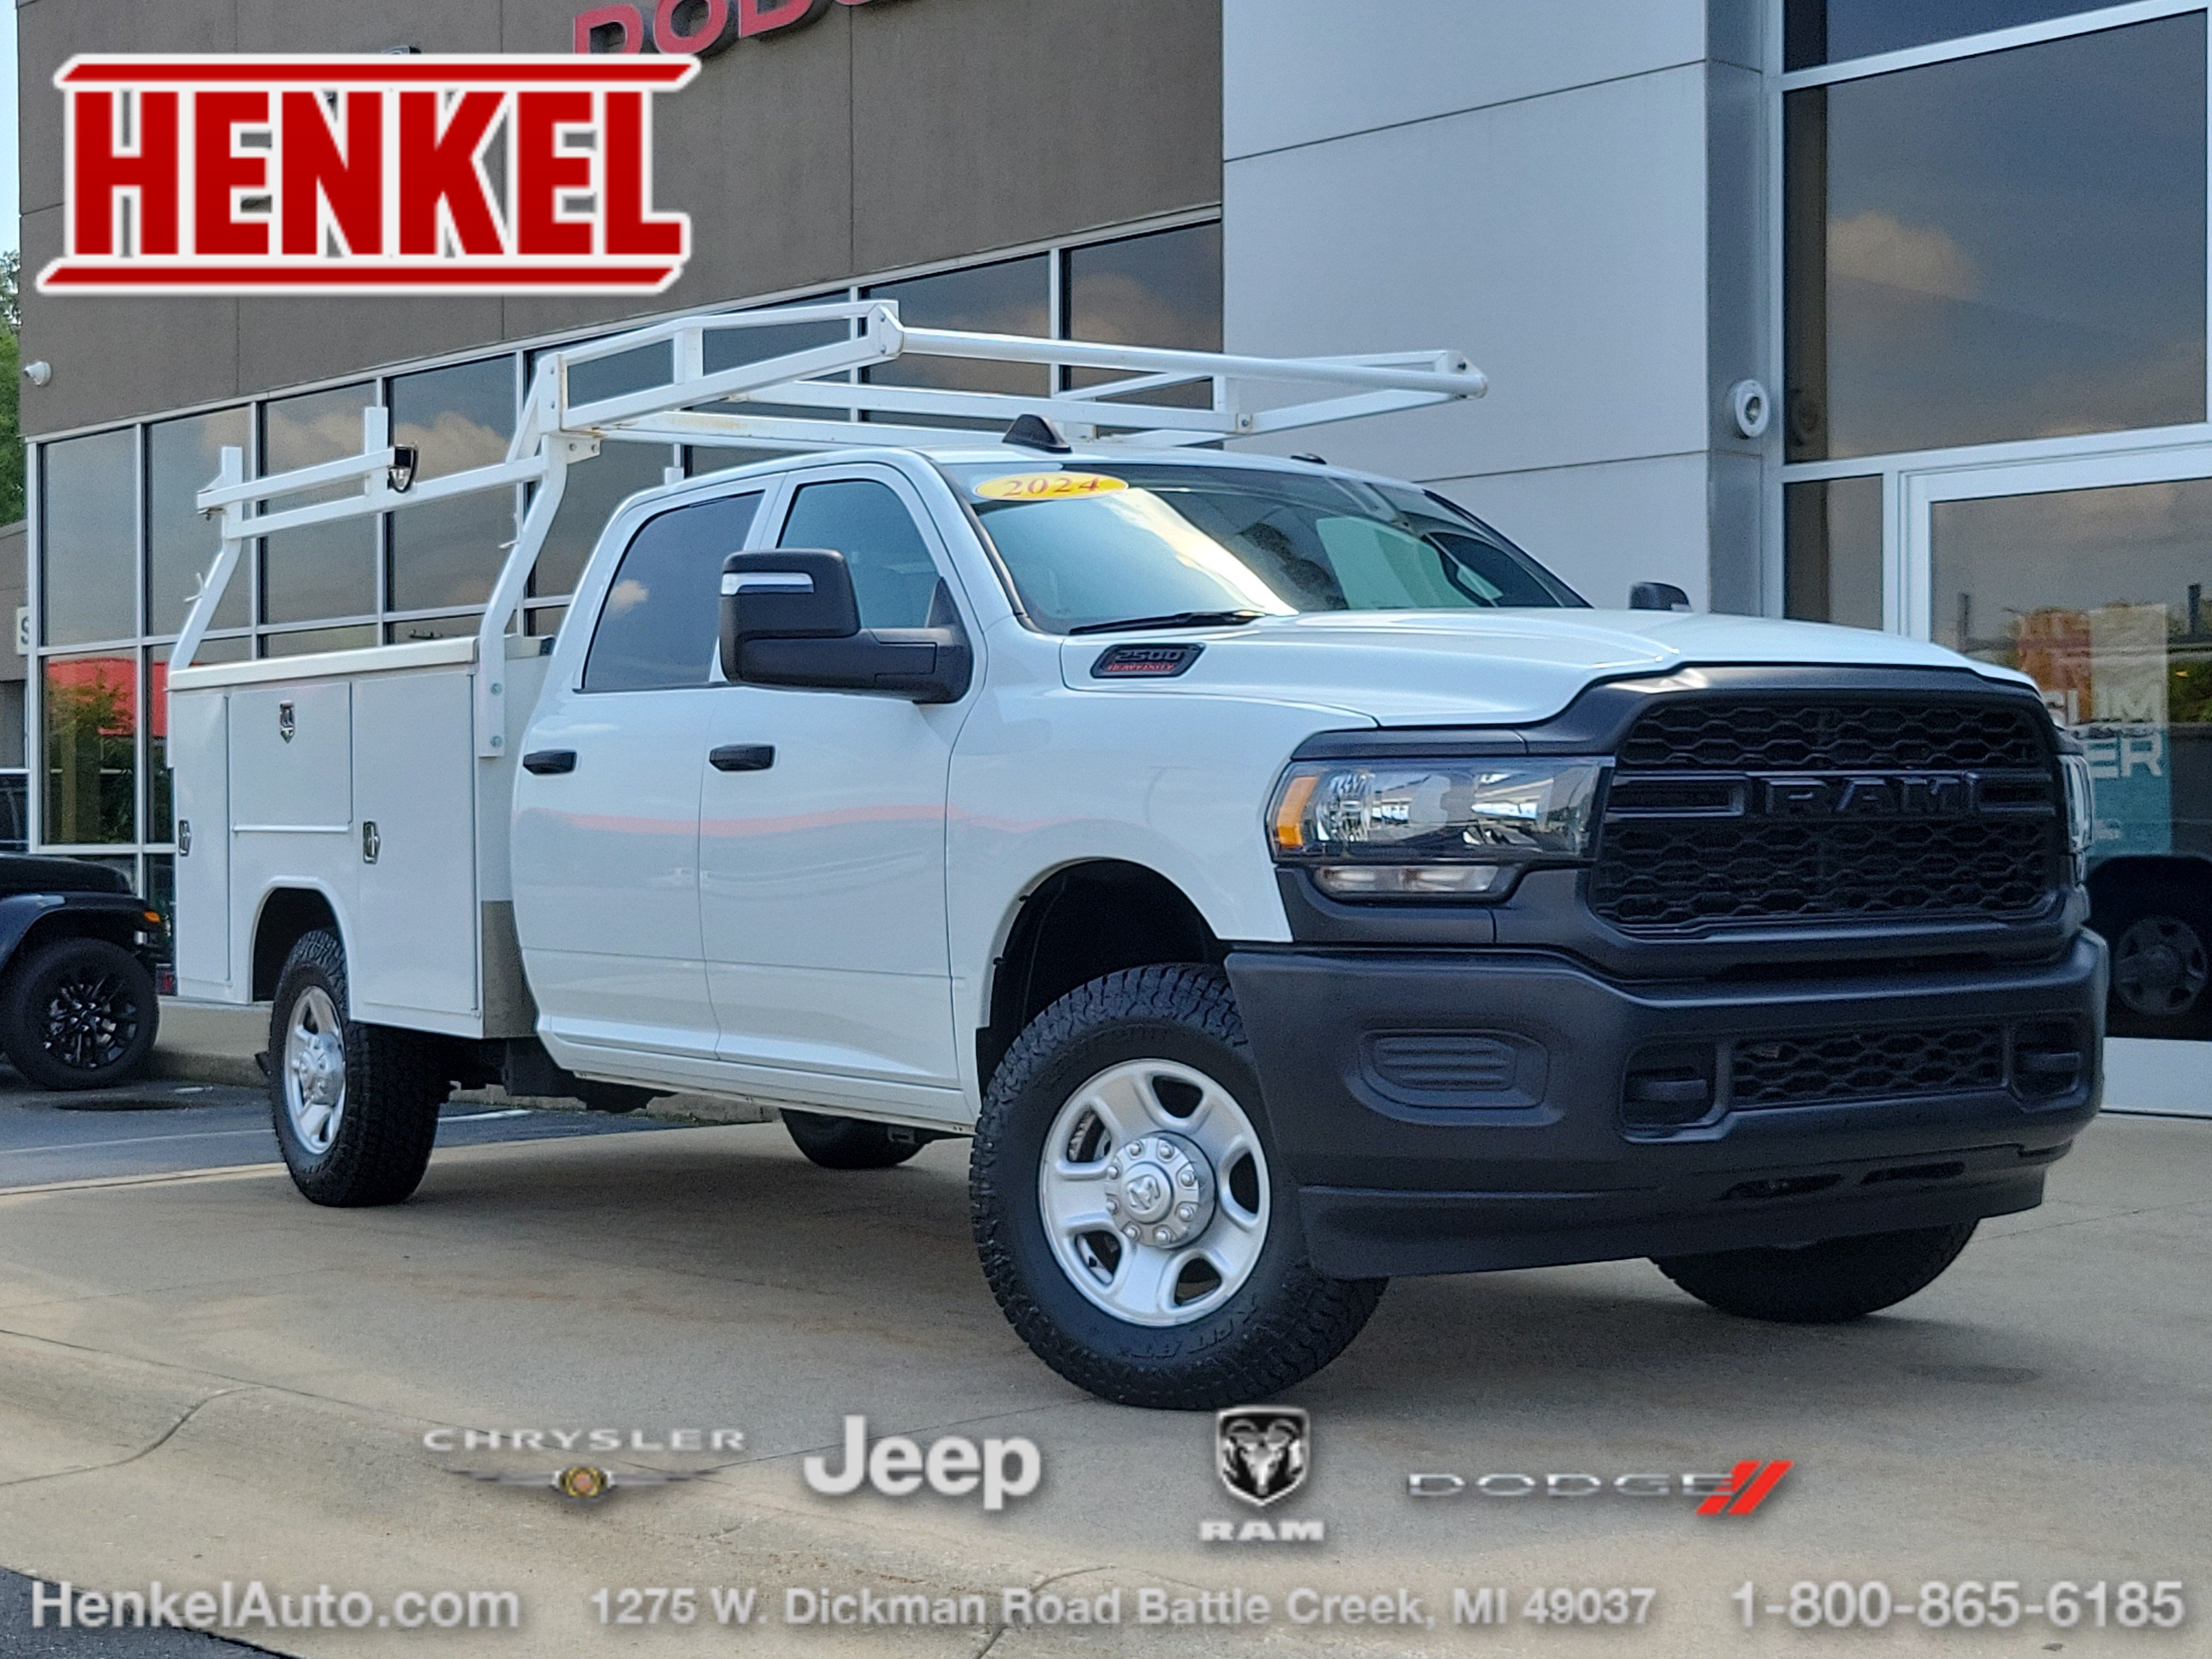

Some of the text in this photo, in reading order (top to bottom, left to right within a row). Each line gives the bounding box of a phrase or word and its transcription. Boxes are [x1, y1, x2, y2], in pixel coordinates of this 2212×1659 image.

[573, 0, 873, 55] DOD
[1002, 477, 1100, 496] 2024
[1114, 648, 1183, 661] 2500
